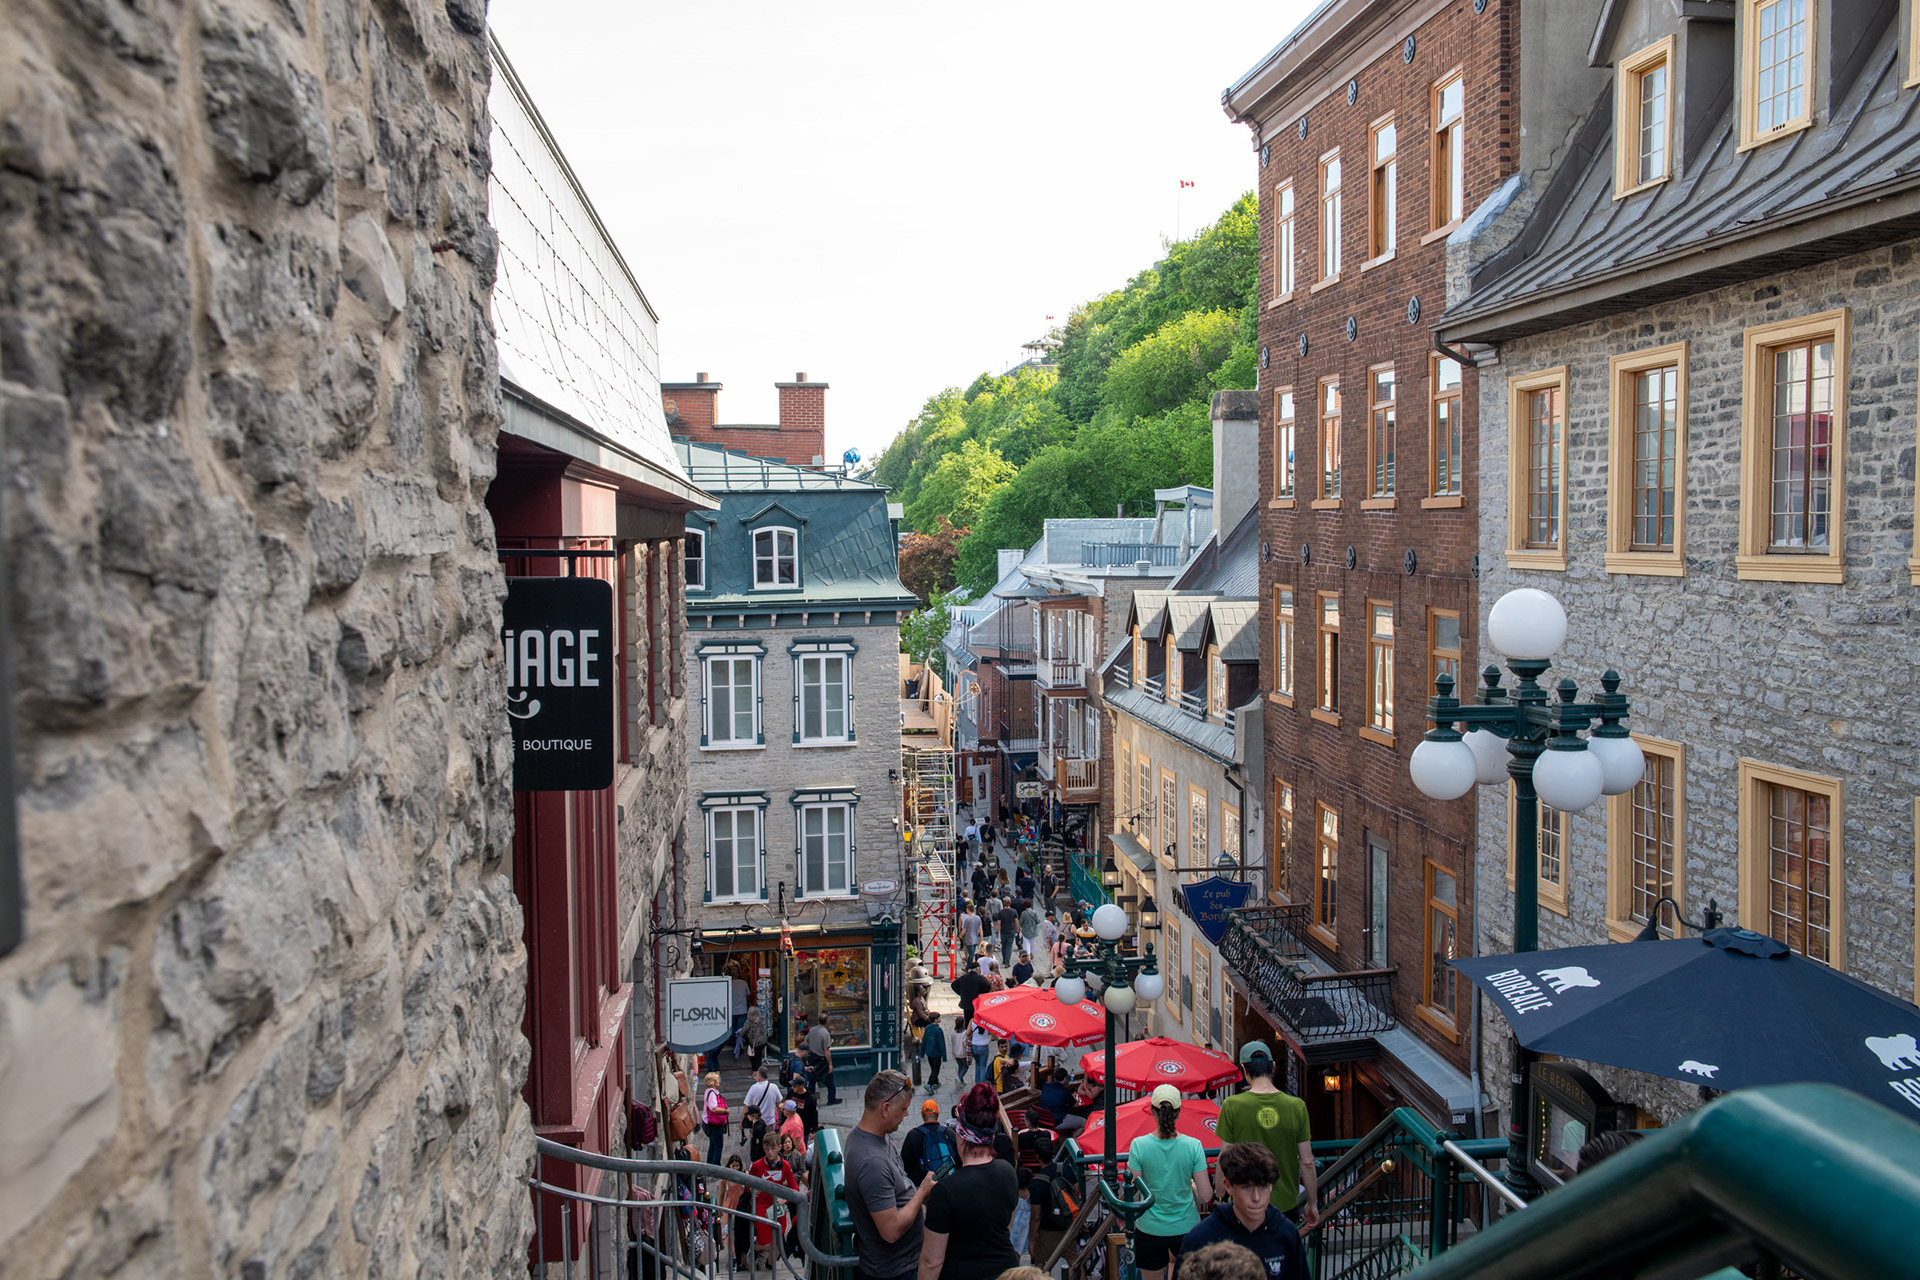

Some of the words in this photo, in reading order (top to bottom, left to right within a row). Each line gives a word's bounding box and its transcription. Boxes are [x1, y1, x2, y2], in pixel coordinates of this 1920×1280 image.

[523, 739, 592, 751] BOUTIQUE
[1203, 890, 1213, 898] Le
[1215, 888, 1231, 899] pub
[1210, 900, 1223, 910] des
[1199, 911, 1224, 923] Borg
[1485, 968, 1553, 1015] BORÉALE
[672, 1006, 726, 1022] FLORIN
[1538, 1063, 1548, 1080] LE
[1550, 1072, 1586, 1105] REPAIRE
